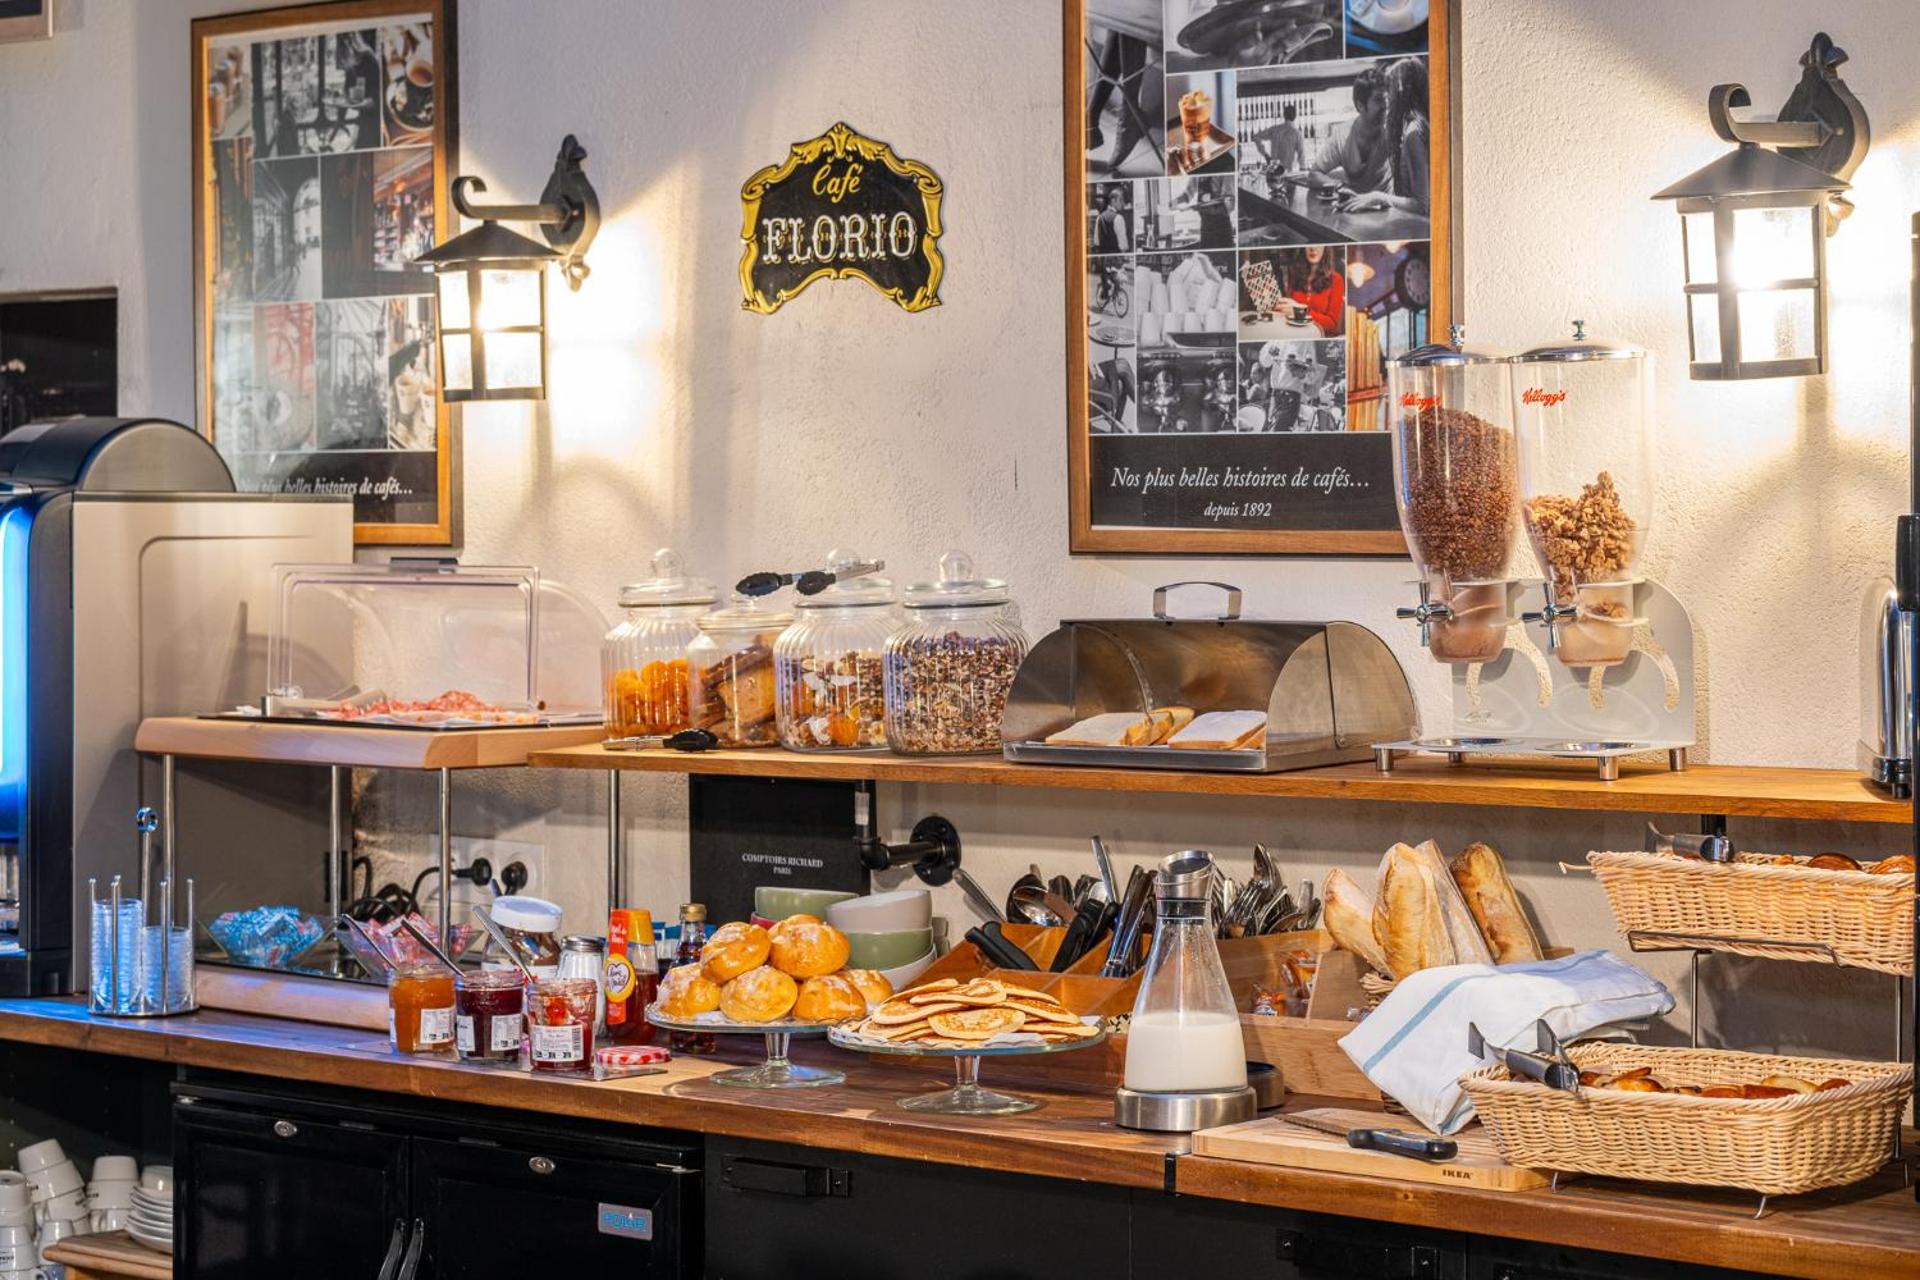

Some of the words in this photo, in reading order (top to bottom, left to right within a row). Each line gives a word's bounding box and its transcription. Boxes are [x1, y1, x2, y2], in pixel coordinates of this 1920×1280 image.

[812, 163, 863, 203] Café
[761, 211, 918, 263] FLORIO
[1522, 387, 1568, 407] Kellogg's
[314, 477, 357, 494] histoires
[359, 476, 372, 495] de
[1110, 467, 1141, 487] Nos
[1142, 467, 1175, 494] plus
[1179, 467, 1219, 487] belles
[1223, 466, 1287, 487] histoires
[1291, 467, 1309, 487] de
[1203, 502, 1239, 522] depuis
[1242, 502, 1272, 517] 1892
[742, 853, 787, 865] COMPTOIRS
[788, 856, 824, 868] RICHARD
[1442, 1169, 1471, 1180] IKEA
